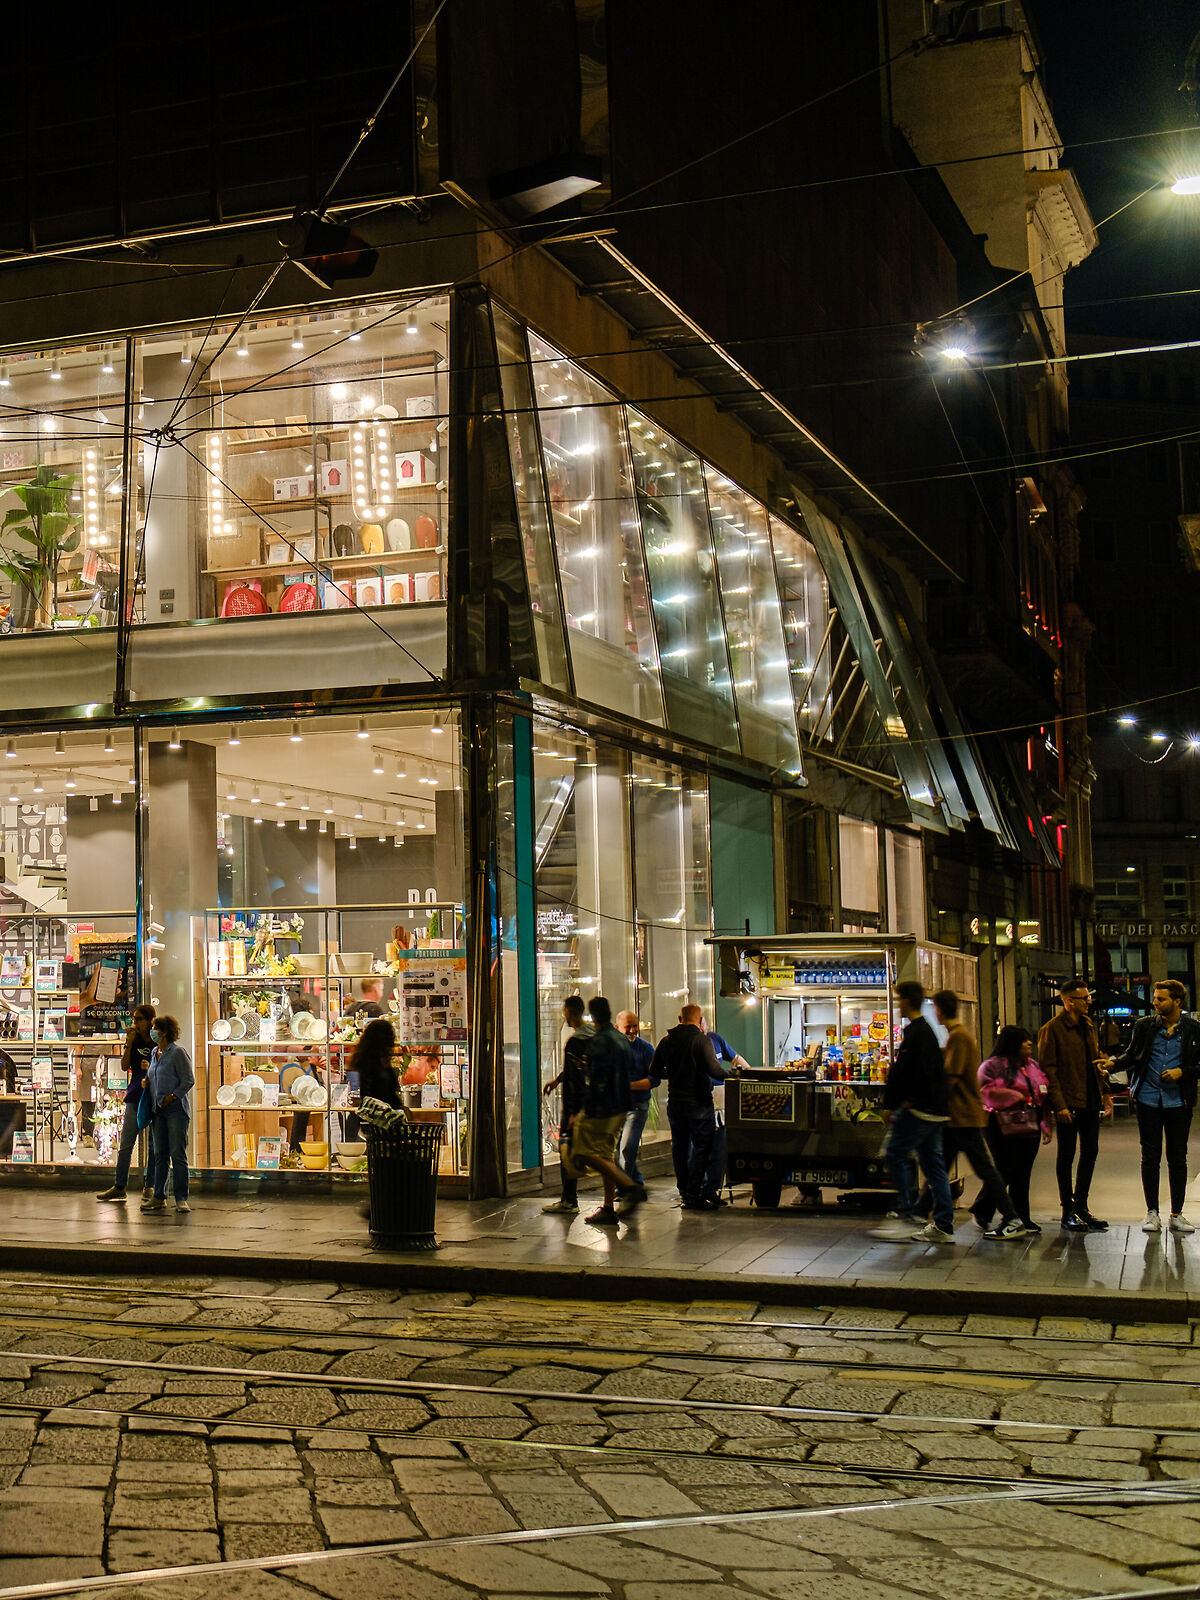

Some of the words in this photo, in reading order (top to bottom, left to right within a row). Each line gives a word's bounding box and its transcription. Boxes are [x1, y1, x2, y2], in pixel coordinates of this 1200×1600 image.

[1128, 924, 1152, 936] DEI
[415, 950, 449, 958] PORTOBELLO
[742, 1084, 792, 1095] CALDARROSTE
